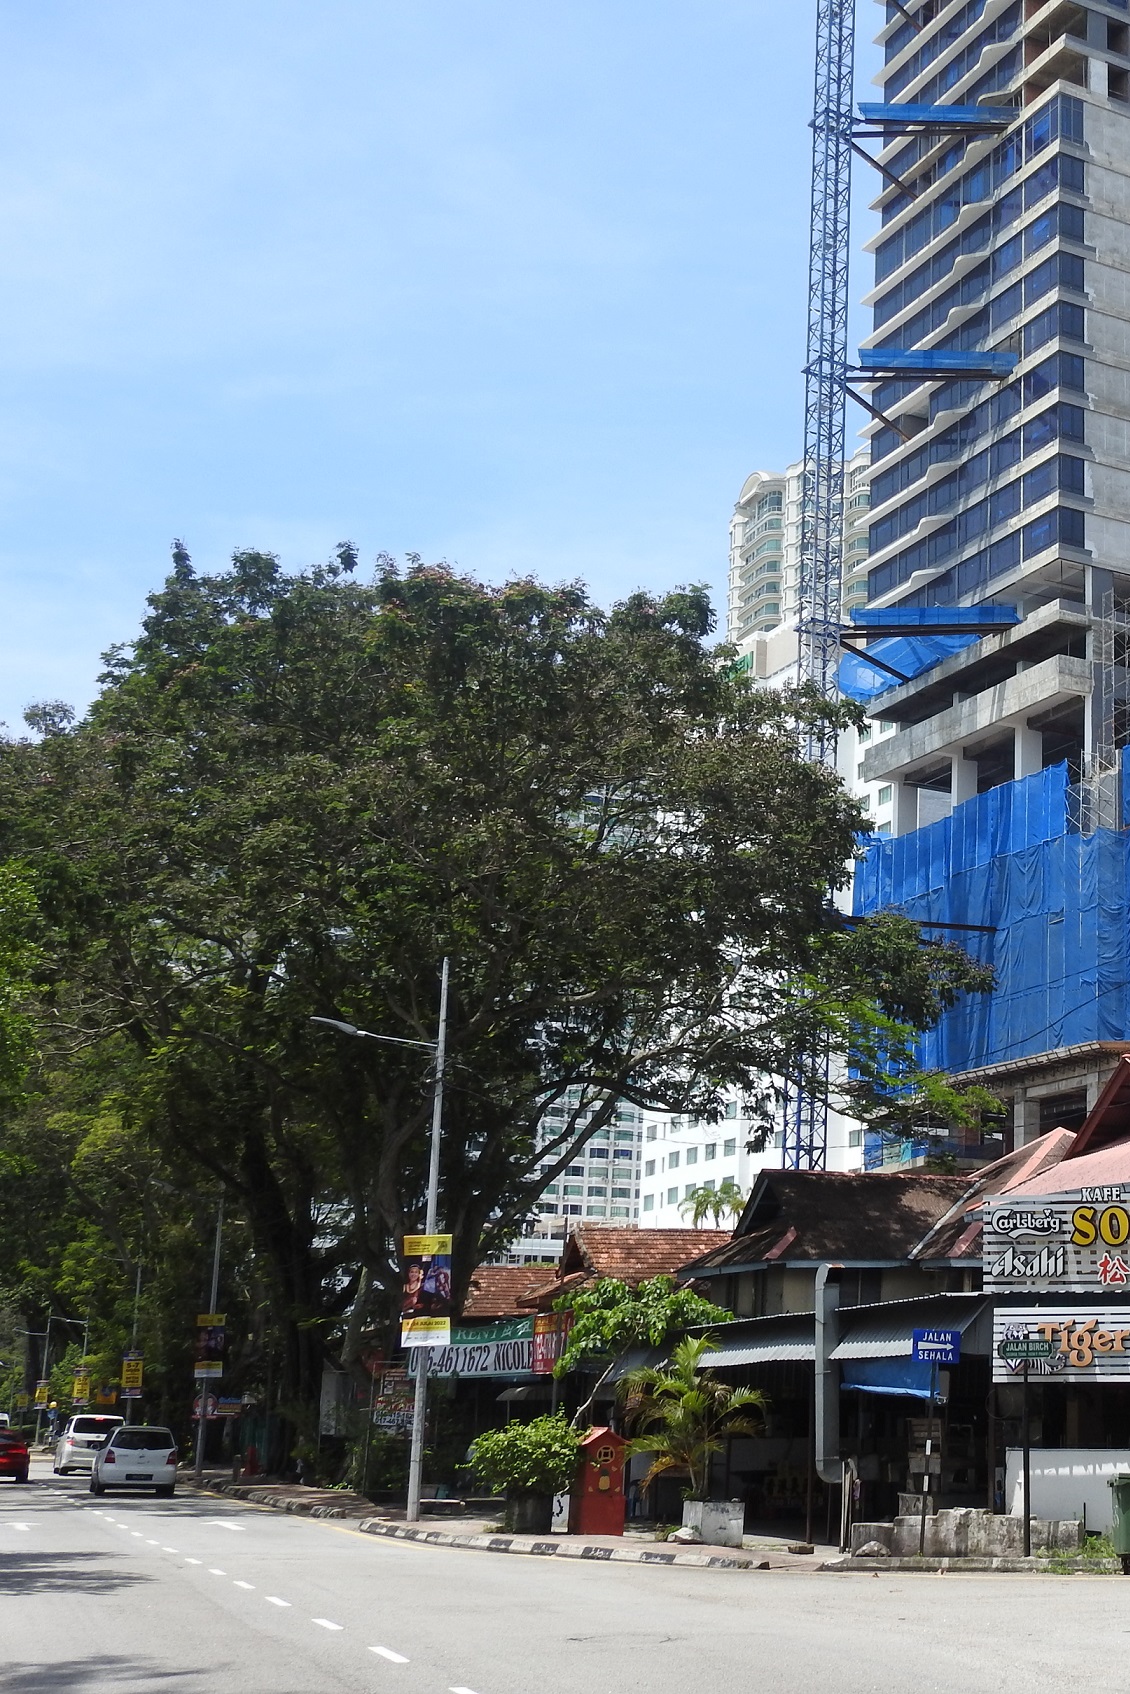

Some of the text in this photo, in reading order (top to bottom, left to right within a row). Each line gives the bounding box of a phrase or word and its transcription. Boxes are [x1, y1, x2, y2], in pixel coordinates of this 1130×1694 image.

[1081, 1187, 1121, 1202] KAFE
[991, 1208, 1061, 1237] Carlsberg
[991, 1247, 1064, 1277] Asahi
[455, 1328, 497, 1340] RENT
[923, 1332, 951, 1342] JALAN
[1006, 1342, 1049, 1352] JALAN BIRCH
[1037, 1319, 1130, 1367] Tiger
[918, 1350, 953, 1361] SEHALA
